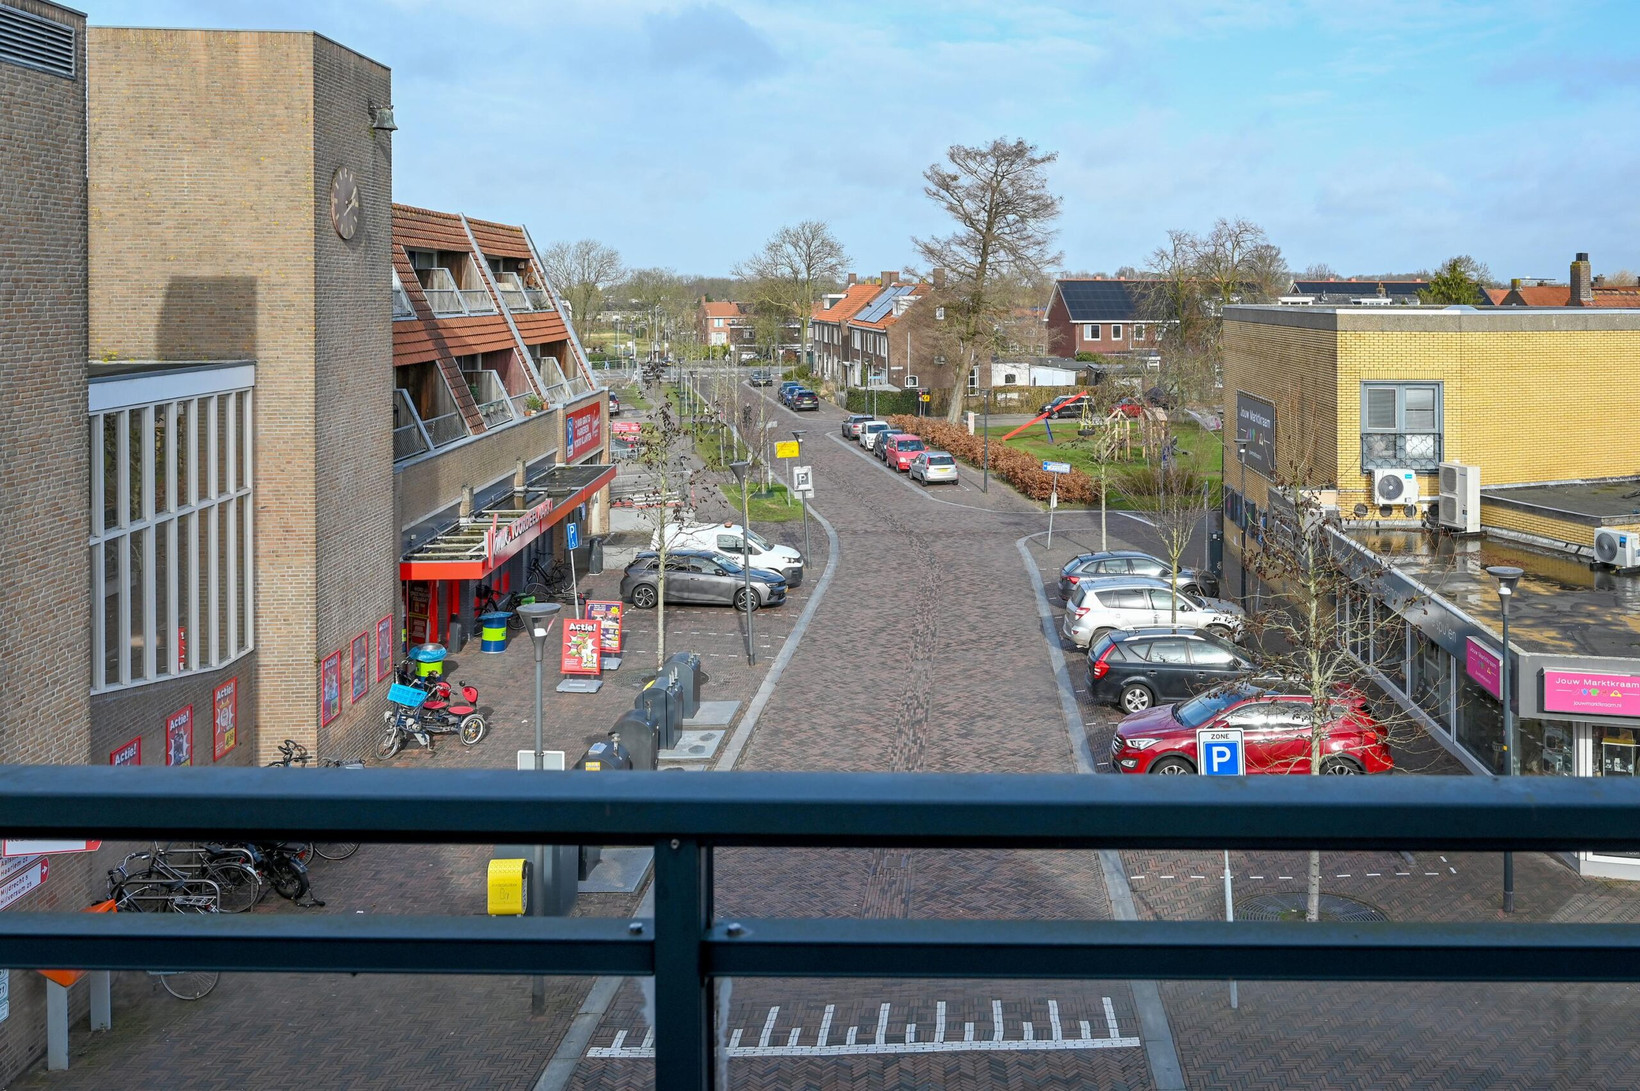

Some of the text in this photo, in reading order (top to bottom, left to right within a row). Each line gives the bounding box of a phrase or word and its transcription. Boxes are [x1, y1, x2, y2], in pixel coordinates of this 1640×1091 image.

[1240, 405, 1249, 419] Jouw
[798, 474, 807, 485] P
[570, 525, 575, 538] P
[569, 622, 597, 632] Actie!
[1556, 677, 1640, 688] Jouw Marktkraam
[216, 682, 234, 702] Actie!
[170, 710, 189, 732] Actie!
[115, 742, 137, 766] Actie!
[1212, 746, 1231, 772] P
[1, 876, 25, 896] Mijdrecht
